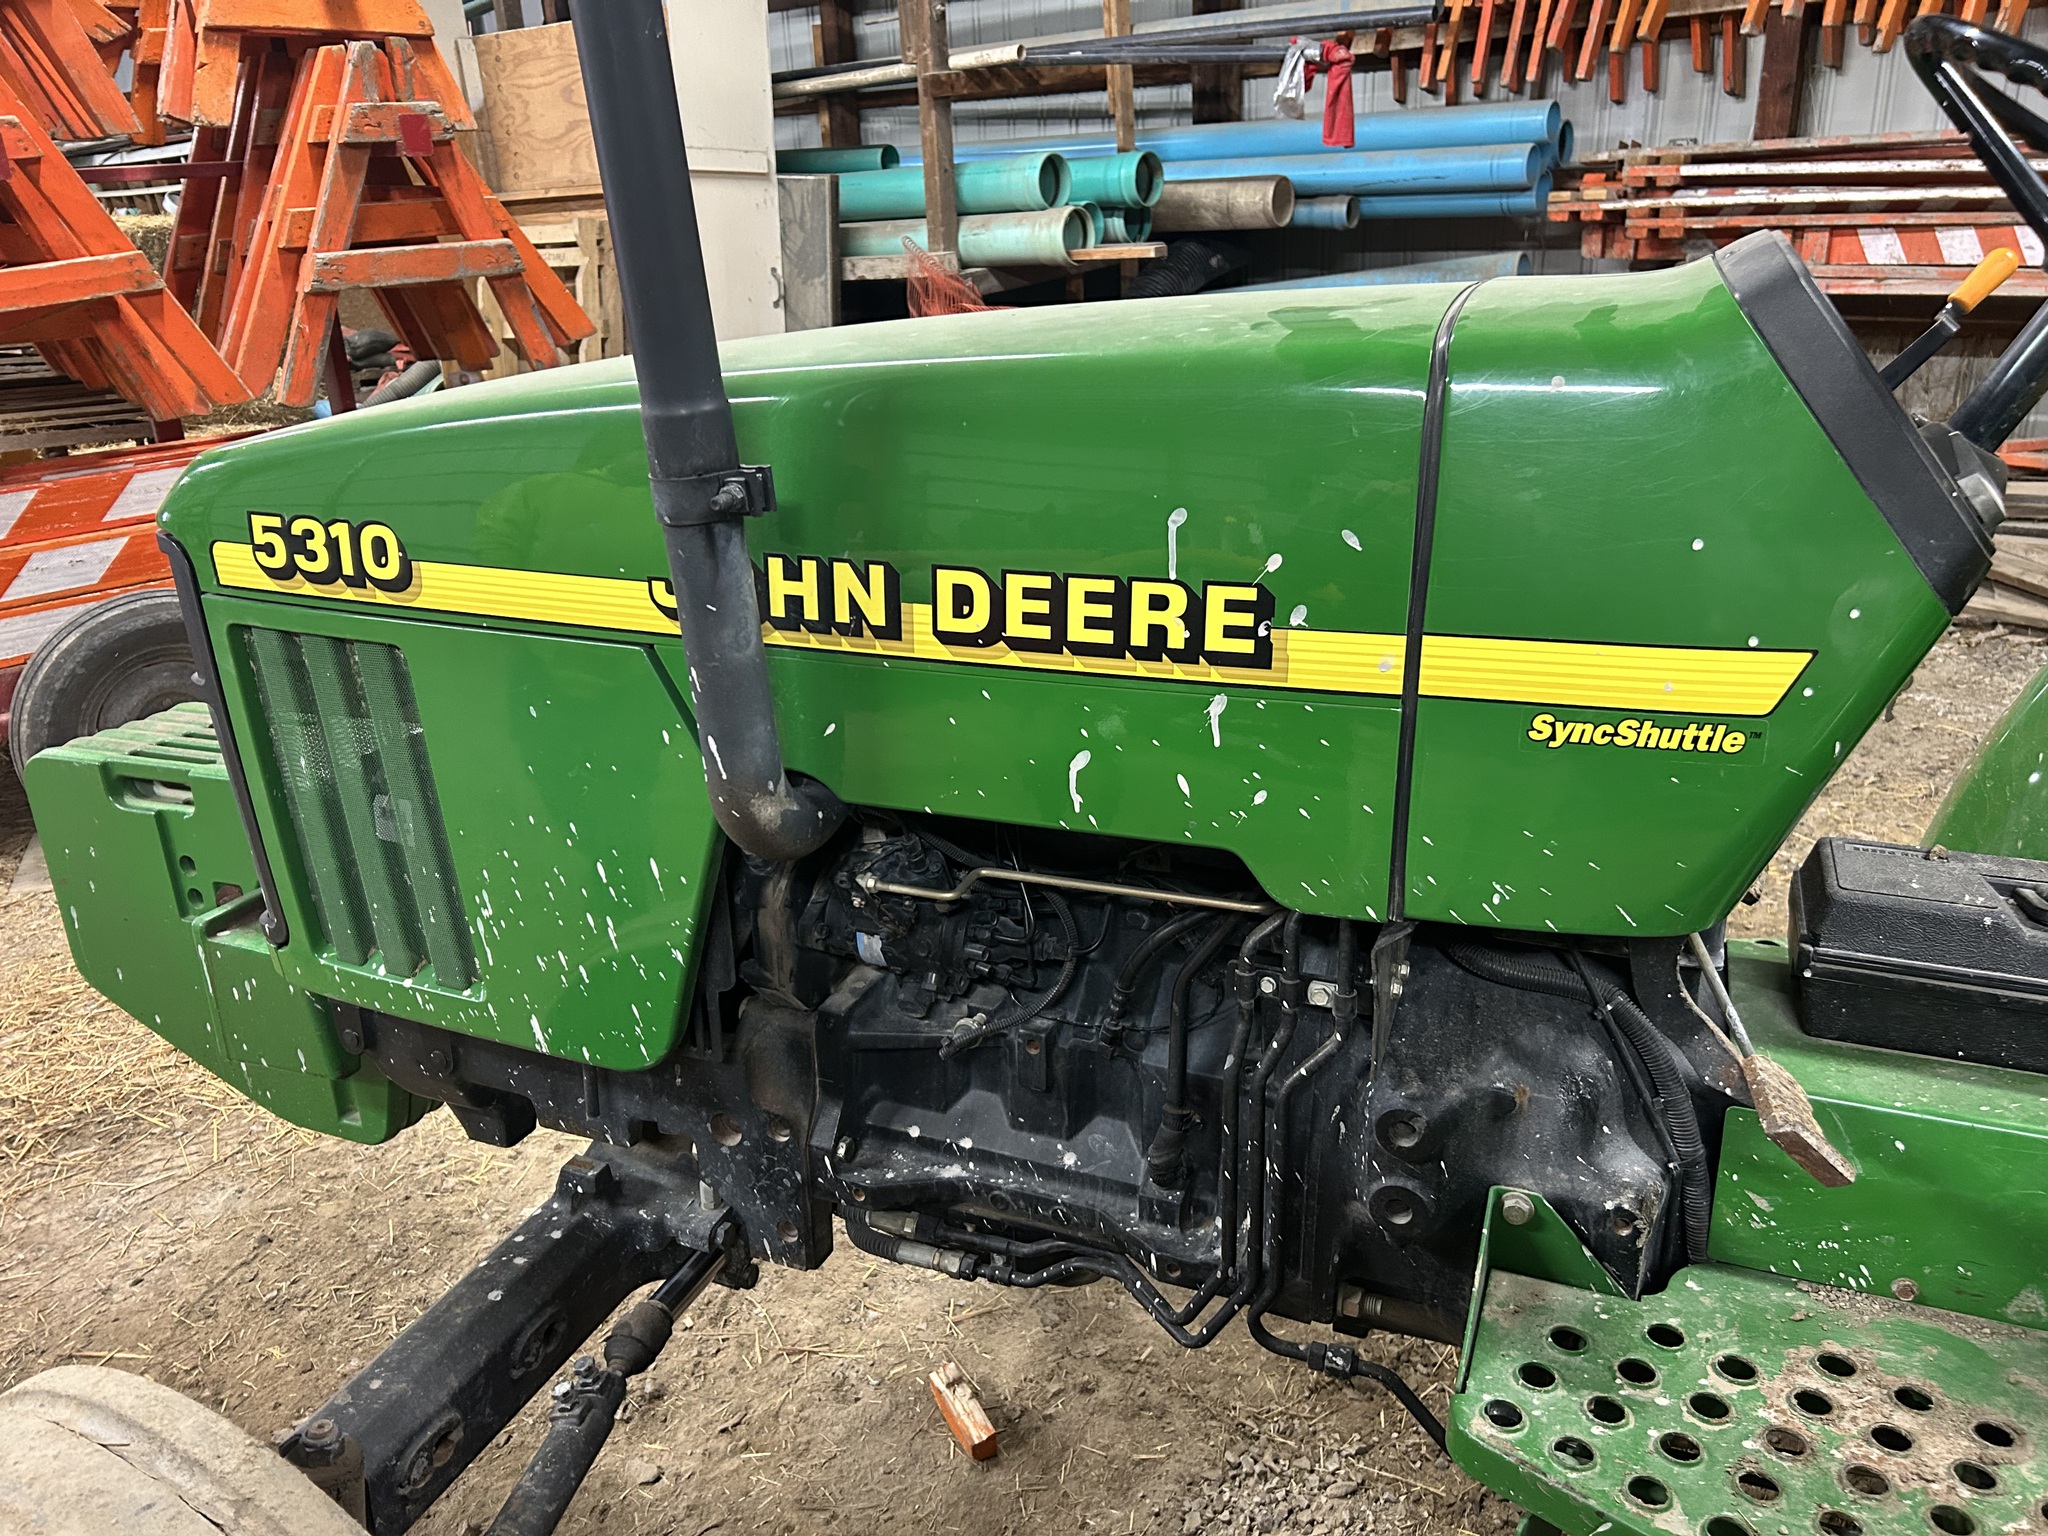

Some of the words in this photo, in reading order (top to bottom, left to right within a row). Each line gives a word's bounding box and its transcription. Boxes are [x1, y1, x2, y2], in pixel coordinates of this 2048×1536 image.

[248, 512, 412, 592] 5310
[648, 553, 902, 641] HN
[932, 564, 1275, 669] DEERE
[1528, 713, 1747, 754] SyncShuttle
